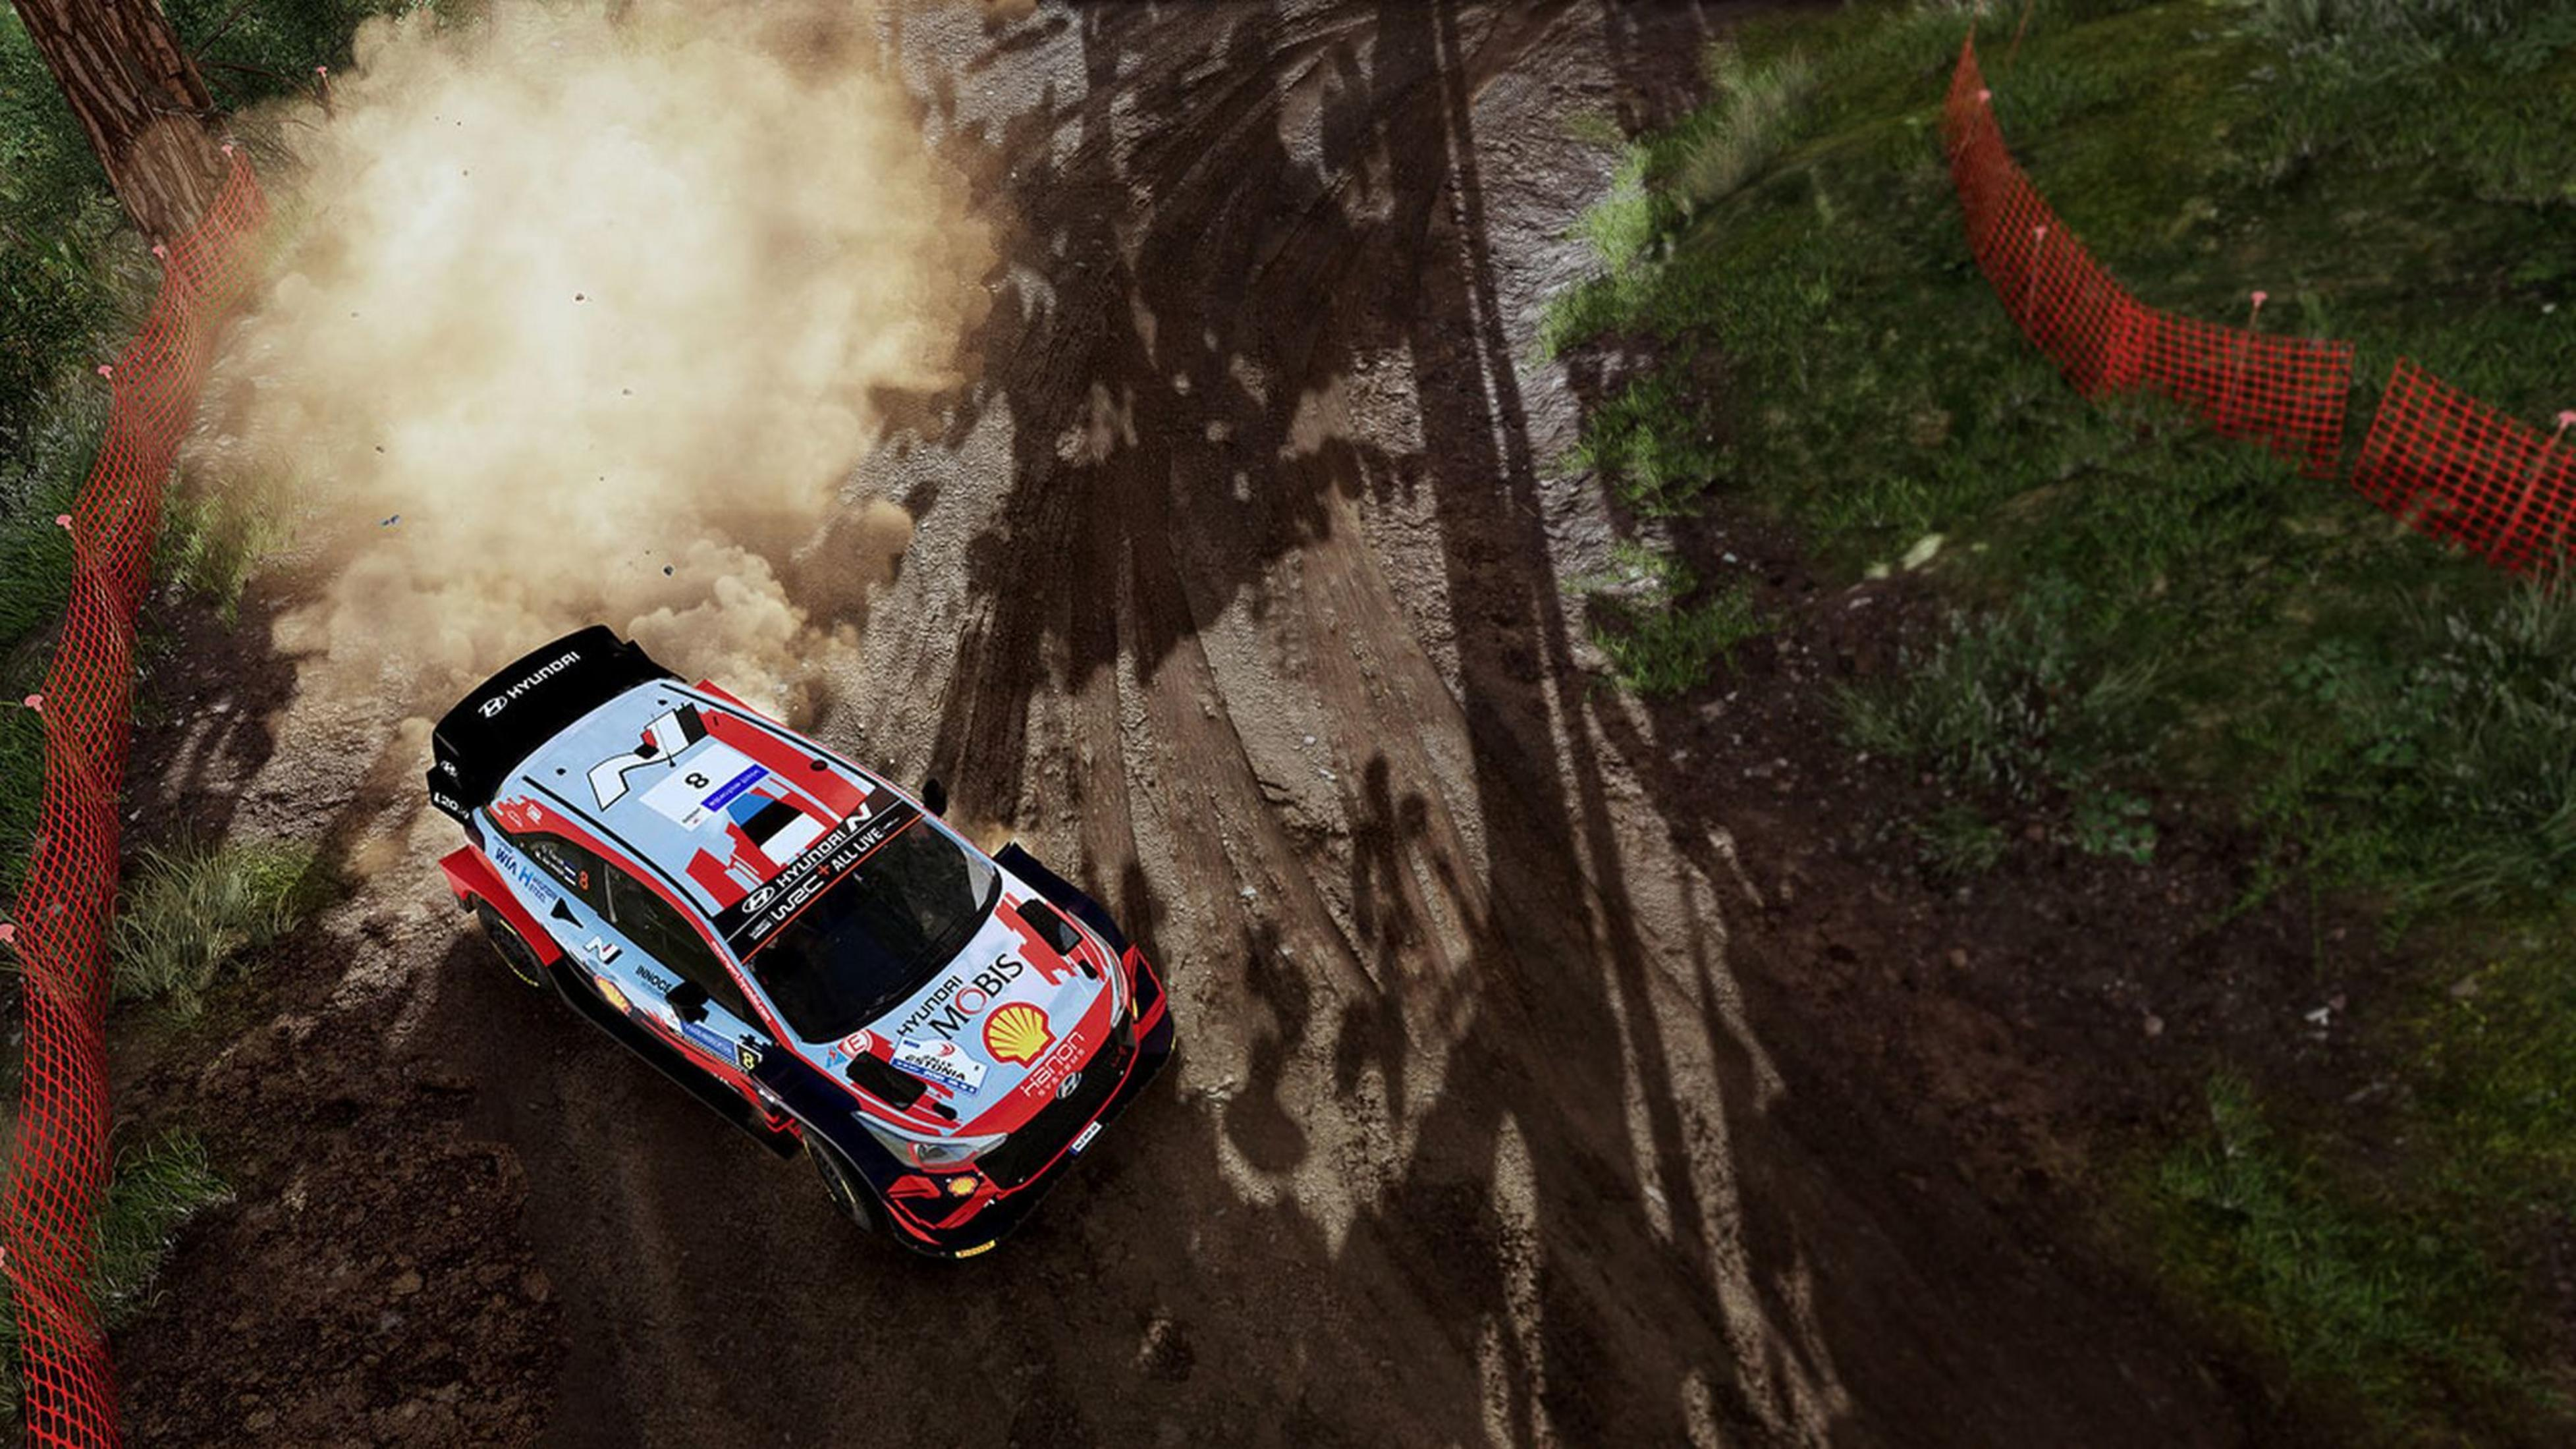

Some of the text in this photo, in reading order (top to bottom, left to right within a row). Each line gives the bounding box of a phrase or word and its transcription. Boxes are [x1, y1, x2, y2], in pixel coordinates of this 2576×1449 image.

[506, 651, 581, 699] HYUNDAI
[685, 773, 709, 789] 8
[776, 829, 847, 888] HYUNDAI
[831, 850, 858, 872] ALL
[853, 827, 885, 853] LIVE
[579, 870, 589, 890] 8
[896, 975, 964, 1036] HYUNDAI
[927, 953, 1024, 1041] MOBIS
[742, 1052, 755, 1070] 8
